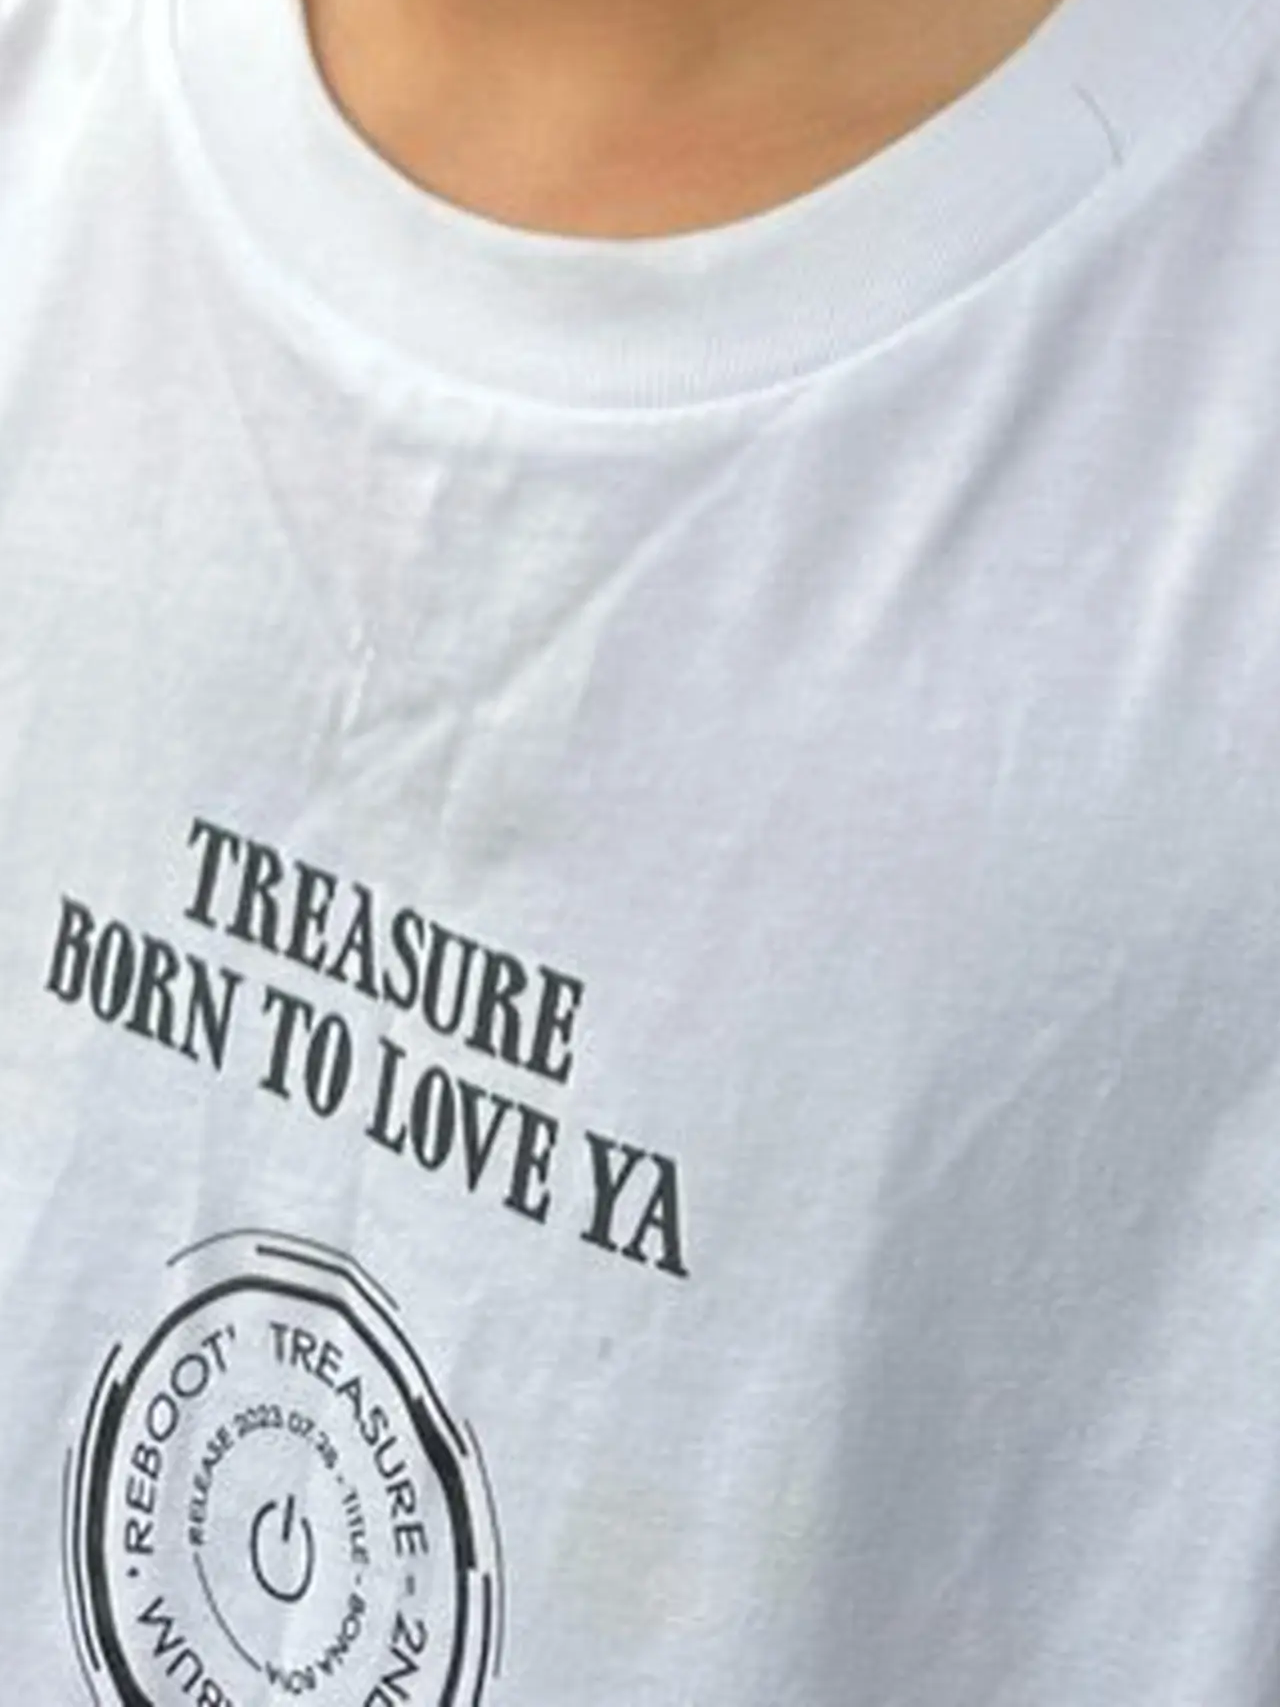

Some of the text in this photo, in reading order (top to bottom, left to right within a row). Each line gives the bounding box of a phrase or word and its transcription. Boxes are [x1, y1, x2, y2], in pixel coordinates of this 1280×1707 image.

[184, 815, 584, 1085] TREASURE
[46, 895, 690, 1281] BORN TO LOVE YA
[188, 1425, 235, 1547] RELEASE
[341, 1487, 370, 1565] TITLE
[268, 1321, 429, 1557] TREASURE
